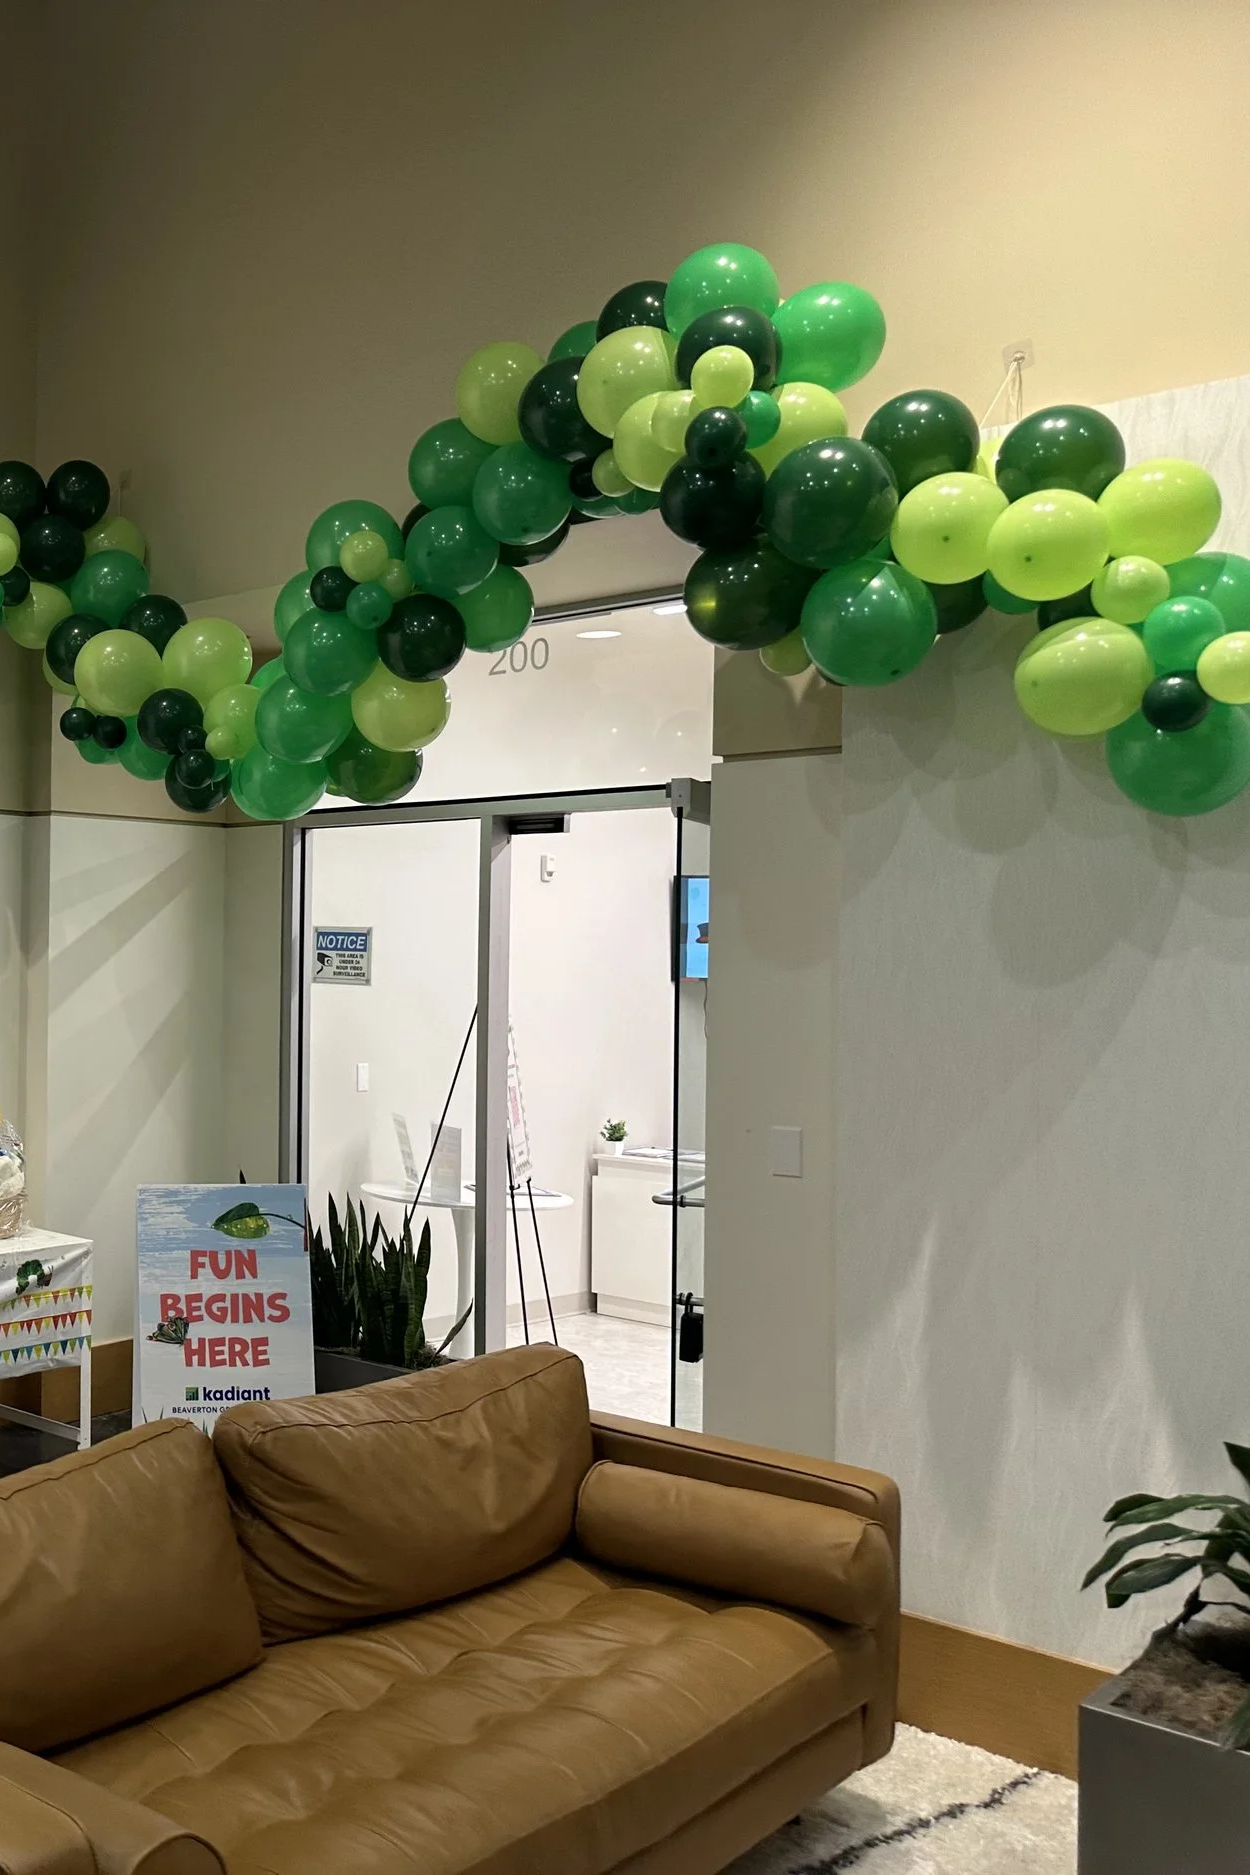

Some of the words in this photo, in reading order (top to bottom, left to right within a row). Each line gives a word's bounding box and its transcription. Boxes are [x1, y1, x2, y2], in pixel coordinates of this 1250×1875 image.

[489, 637, 549, 676] 200
[318, 935, 366, 949] NOTICE
[190, 1249, 258, 1280] FUN
[160, 1292, 290, 1324] BEGINS
[183, 1336, 271, 1368] HERE
[203, 1386, 271, 1401] kadiant
[172, 1406, 218, 1414] BEAVERTON
